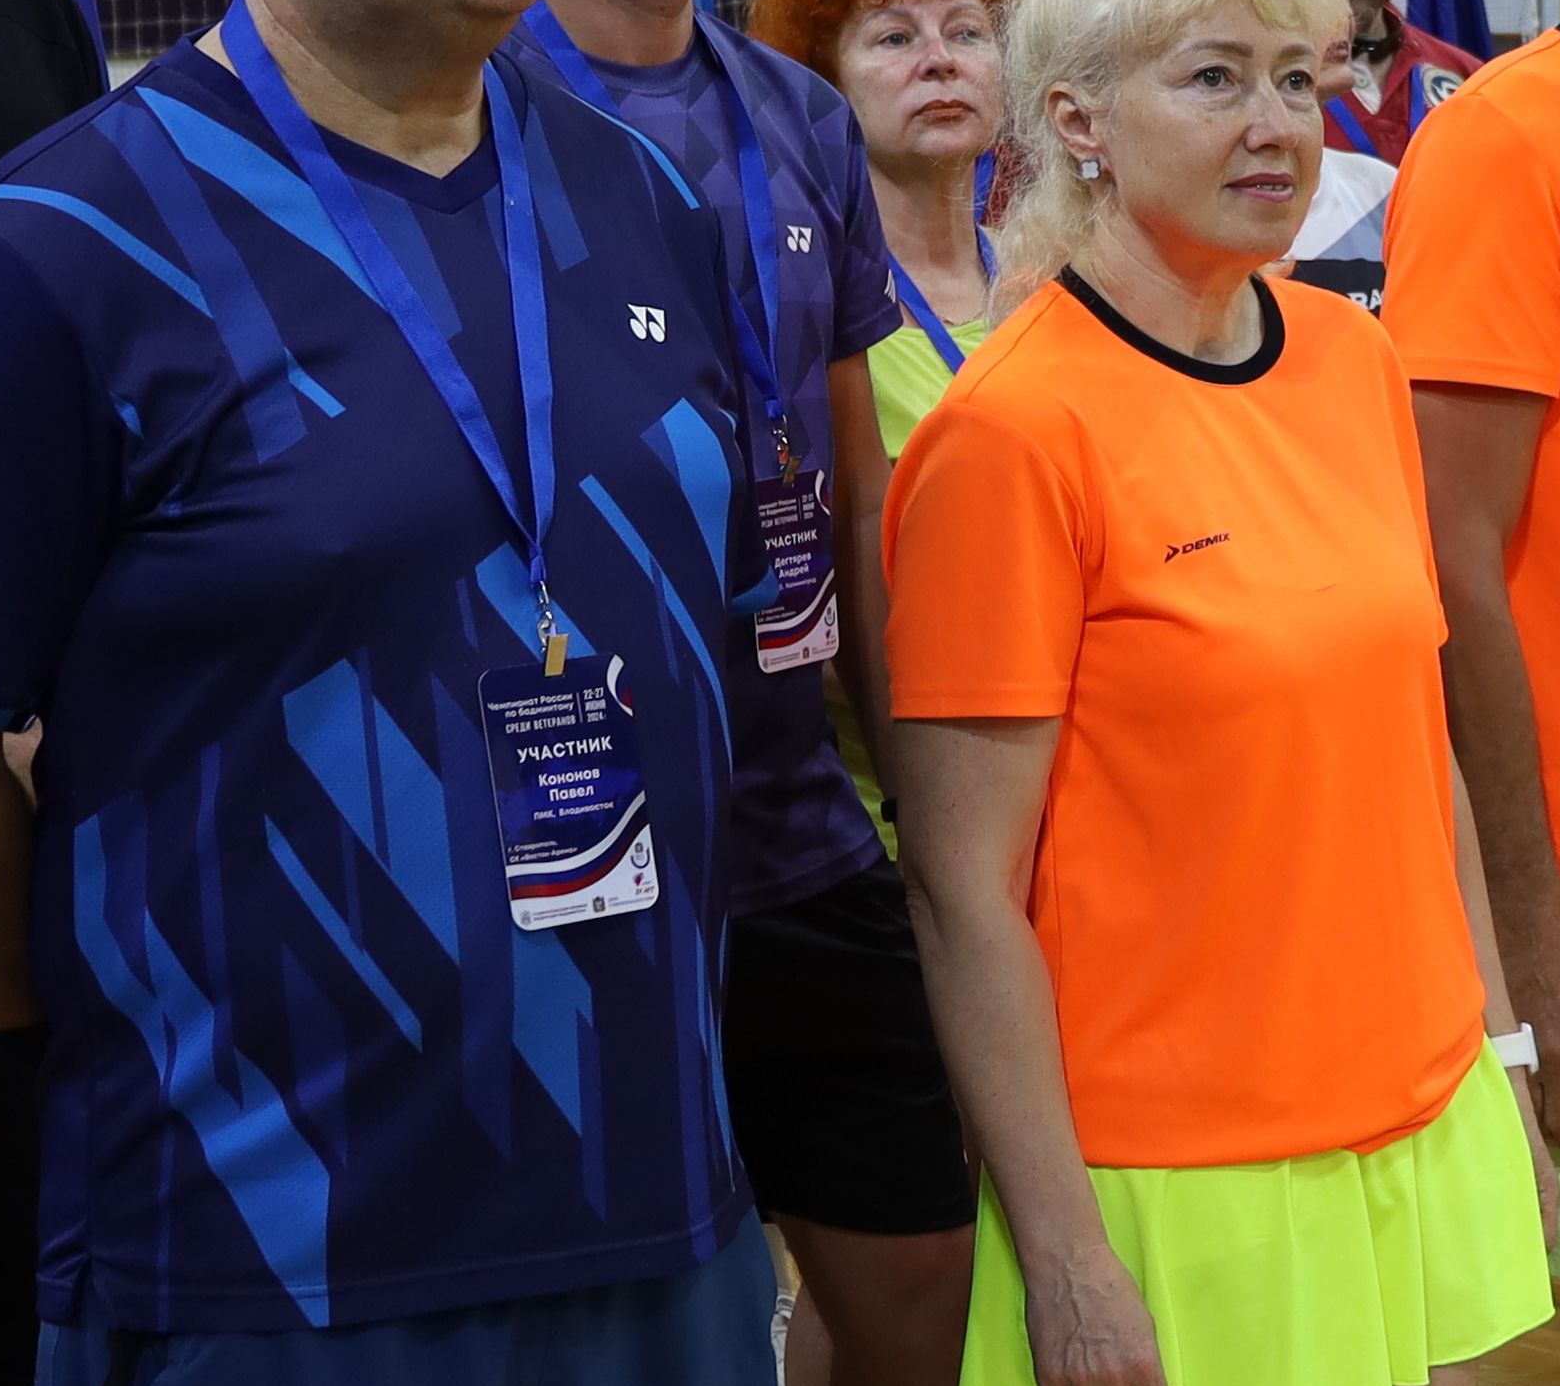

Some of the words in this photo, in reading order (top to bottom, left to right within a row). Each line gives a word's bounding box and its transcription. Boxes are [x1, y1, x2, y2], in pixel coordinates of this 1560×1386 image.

[764, 528, 818, 551] УЧАСТНИК
[1181, 532, 1230, 555] DEMIX
[774, 552, 813, 570] Дегтярев
[778, 563, 810, 579] Андрей
[487, 698, 539, 711] Чемпионат
[540, 693, 573, 704] России
[582, 687, 604, 701] 22-27
[504, 710, 517, 719] по
[518, 702, 575, 718] бадминтону
[505, 721, 532, 734] СРЕДИ
[533, 714, 577, 730] ВЕТЕРАНОВ
[516, 735, 614, 764] УЧАСТНИК
[538, 768, 601, 788] Кононов
[549, 785, 595, 802] Павел
[559, 801, 615, 817] Владивосток
